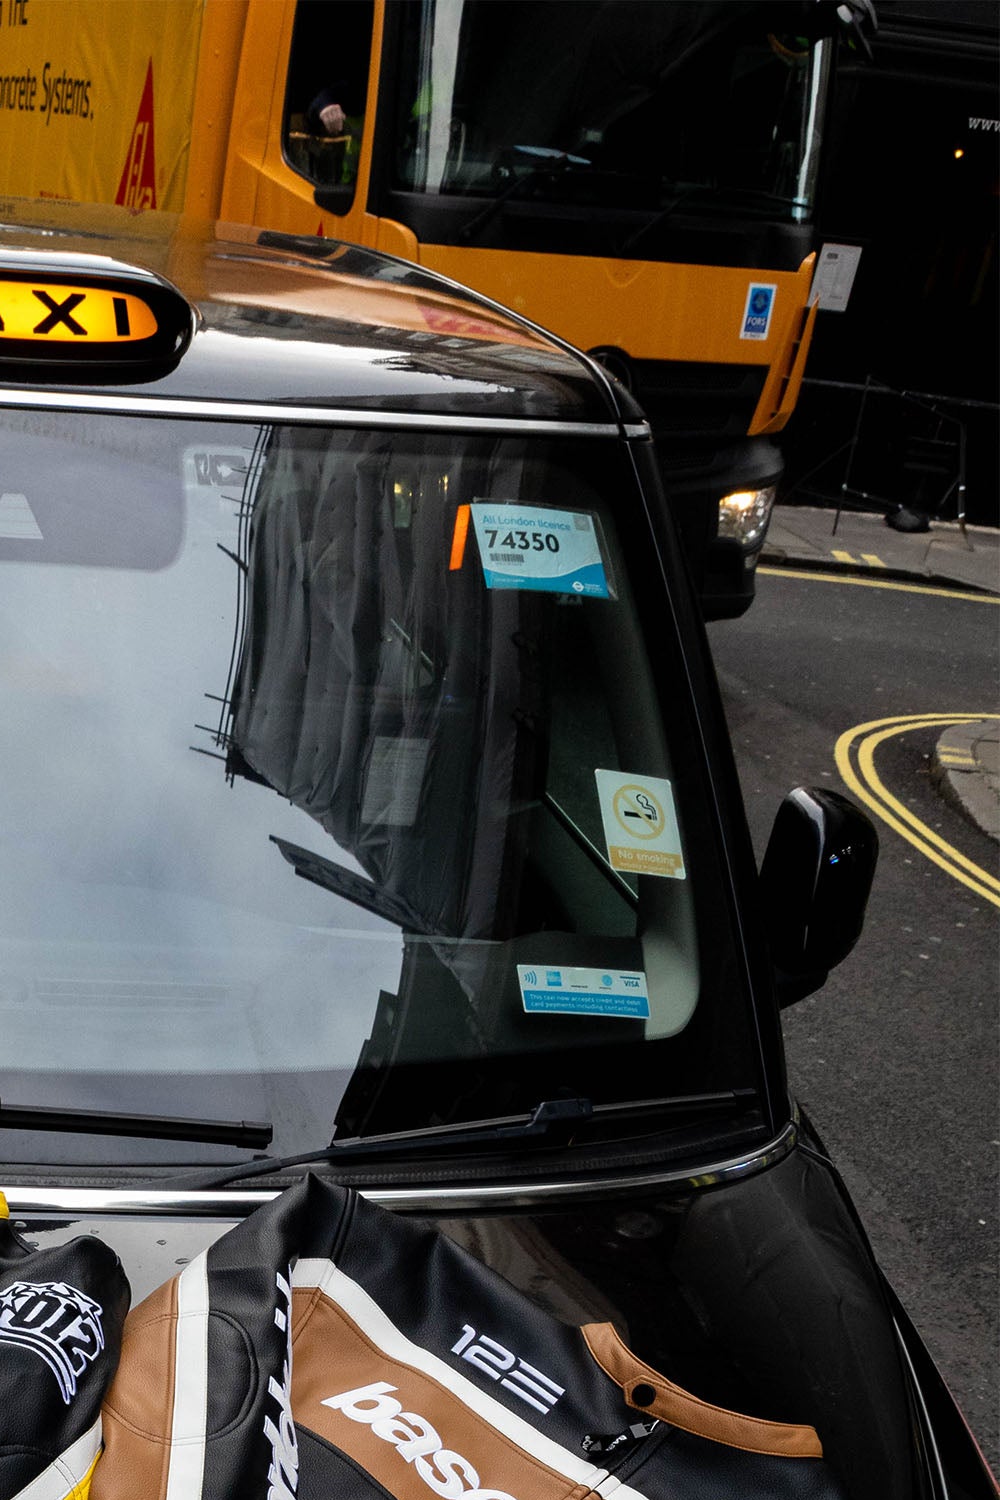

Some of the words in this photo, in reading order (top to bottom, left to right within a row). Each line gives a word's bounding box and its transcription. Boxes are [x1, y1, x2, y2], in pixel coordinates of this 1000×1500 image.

[746, 316, 767, 327] FORS
[482, 514, 496, 525] All
[499, 516, 536, 528] London
[537, 519, 572, 532] licence
[484, 529, 560, 553] 74350
[618, 849, 633, 860] No
[635, 853, 676, 867] smoking
[623, 980, 640, 988] VISA
[529, 993, 543, 1001] This
[571, 996, 595, 1004] accepts
[545, 1002, 575, 1010] payments
[576, 1003, 604, 1012] including
[4, 1290, 102, 1377] 012
